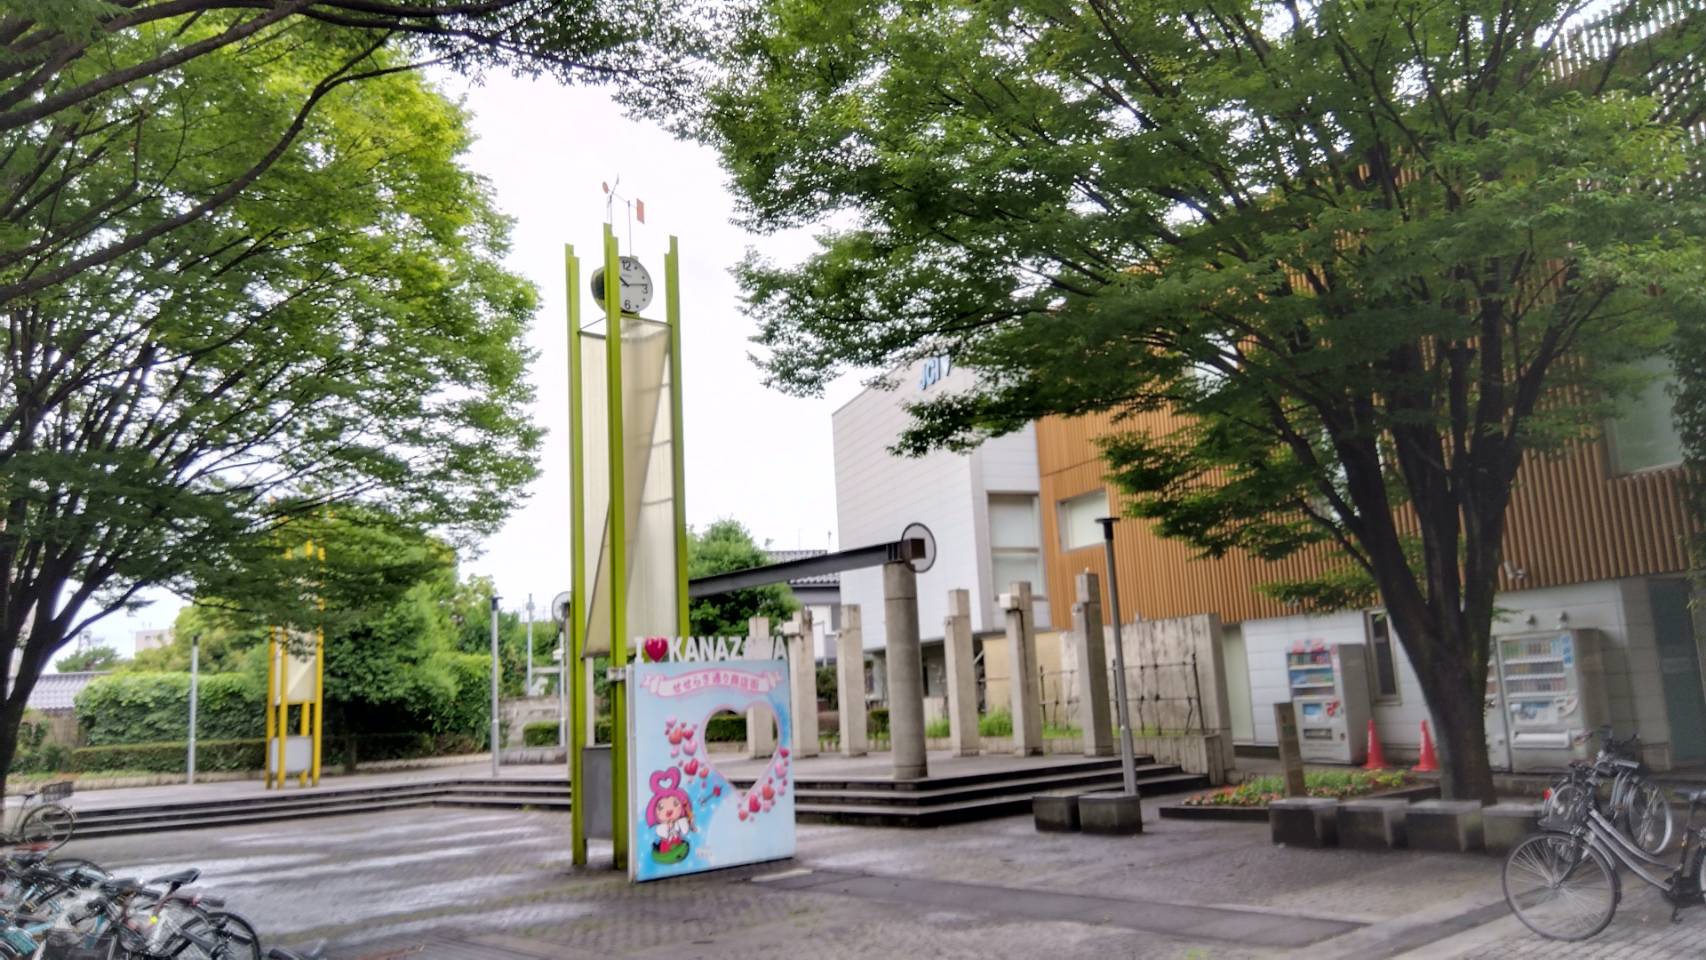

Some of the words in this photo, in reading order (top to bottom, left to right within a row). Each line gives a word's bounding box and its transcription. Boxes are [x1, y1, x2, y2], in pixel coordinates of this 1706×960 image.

[621, 260, 632, 271] 12
[624, 299, 631, 310] 6
[668, 635, 787, 662] KANAZA
